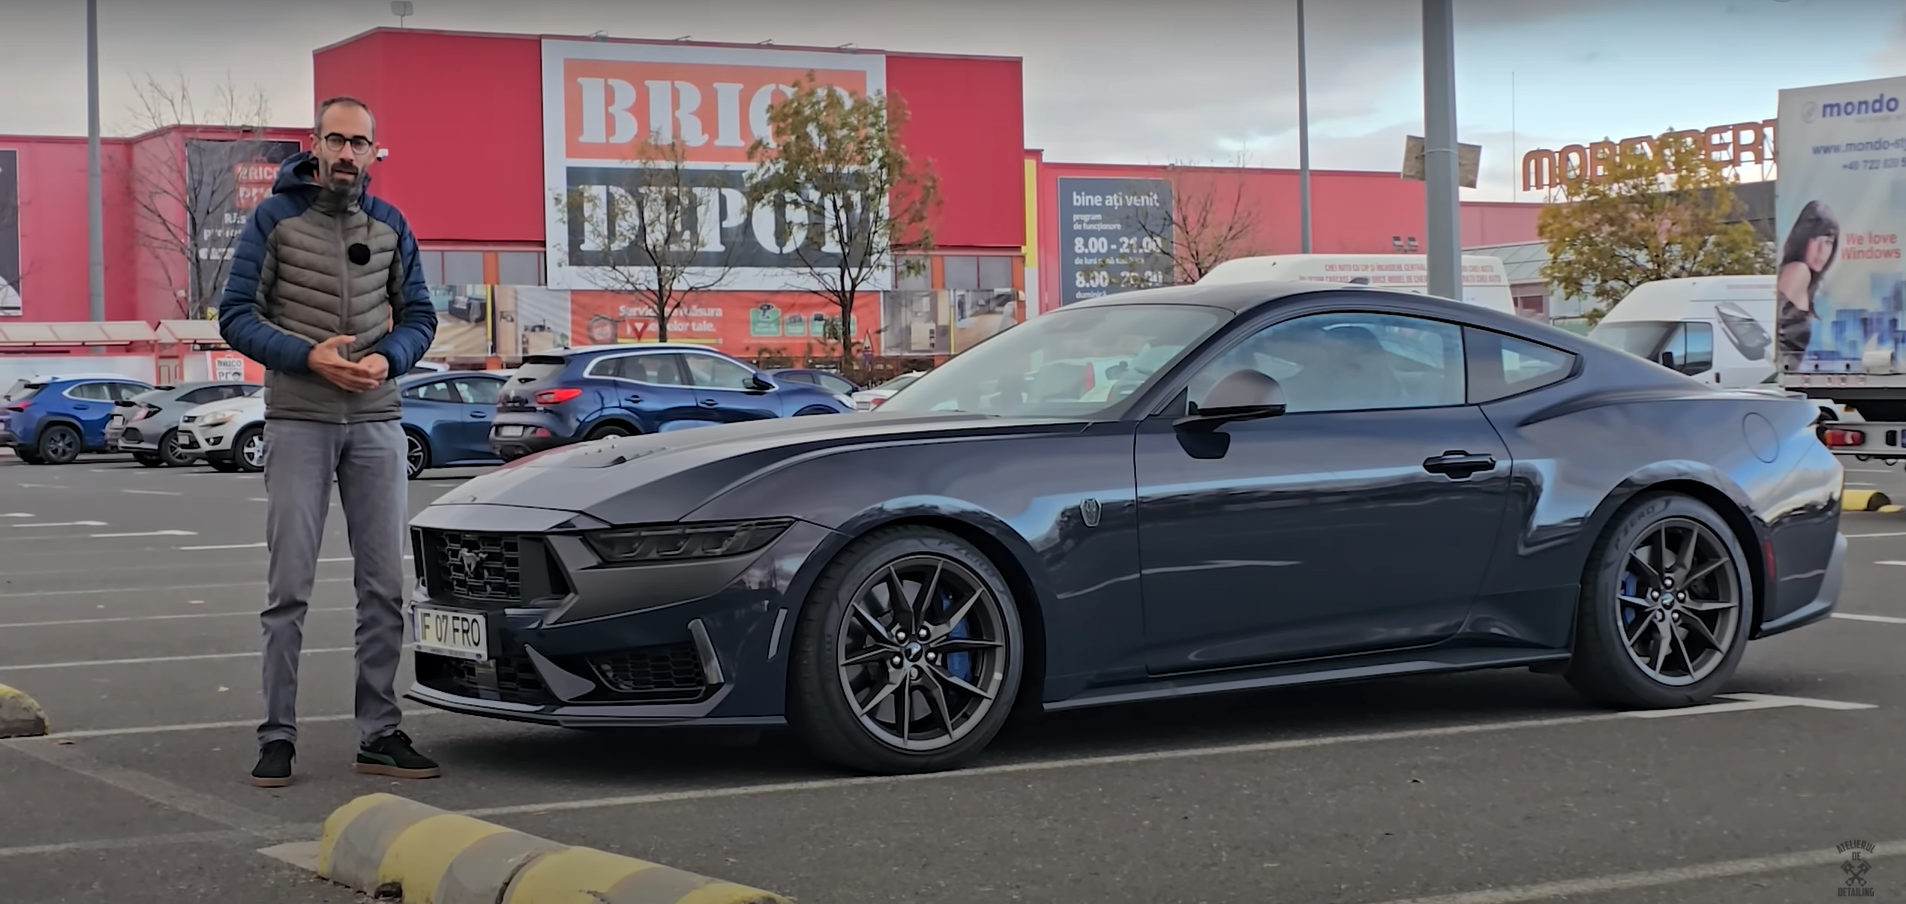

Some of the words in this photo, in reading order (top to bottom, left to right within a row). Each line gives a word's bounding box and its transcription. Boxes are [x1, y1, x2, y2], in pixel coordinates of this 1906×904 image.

[1822, 93, 1899, 118] mondo
[1863, 159, 1880, 170] 722
[1073, 191, 1103, 206] bine
[1125, 192, 1159, 207] venit
[1073, 214, 1102, 223] program
[1074, 237, 1108, 253] 8.00
[1119, 237, 1162, 253] 21.00
[1846, 233, 1865, 245] We
[1869, 232, 1897, 245] love
[1841, 247, 1901, 260] Windows
[1074, 257, 1083, 265] de
[1075, 271, 1109, 288] 8.00
[691, 320, 716, 332] tale.
[421, 612, 431, 641] IF
[435, 614, 448, 643] 07
[452, 615, 481, 647] FRO
